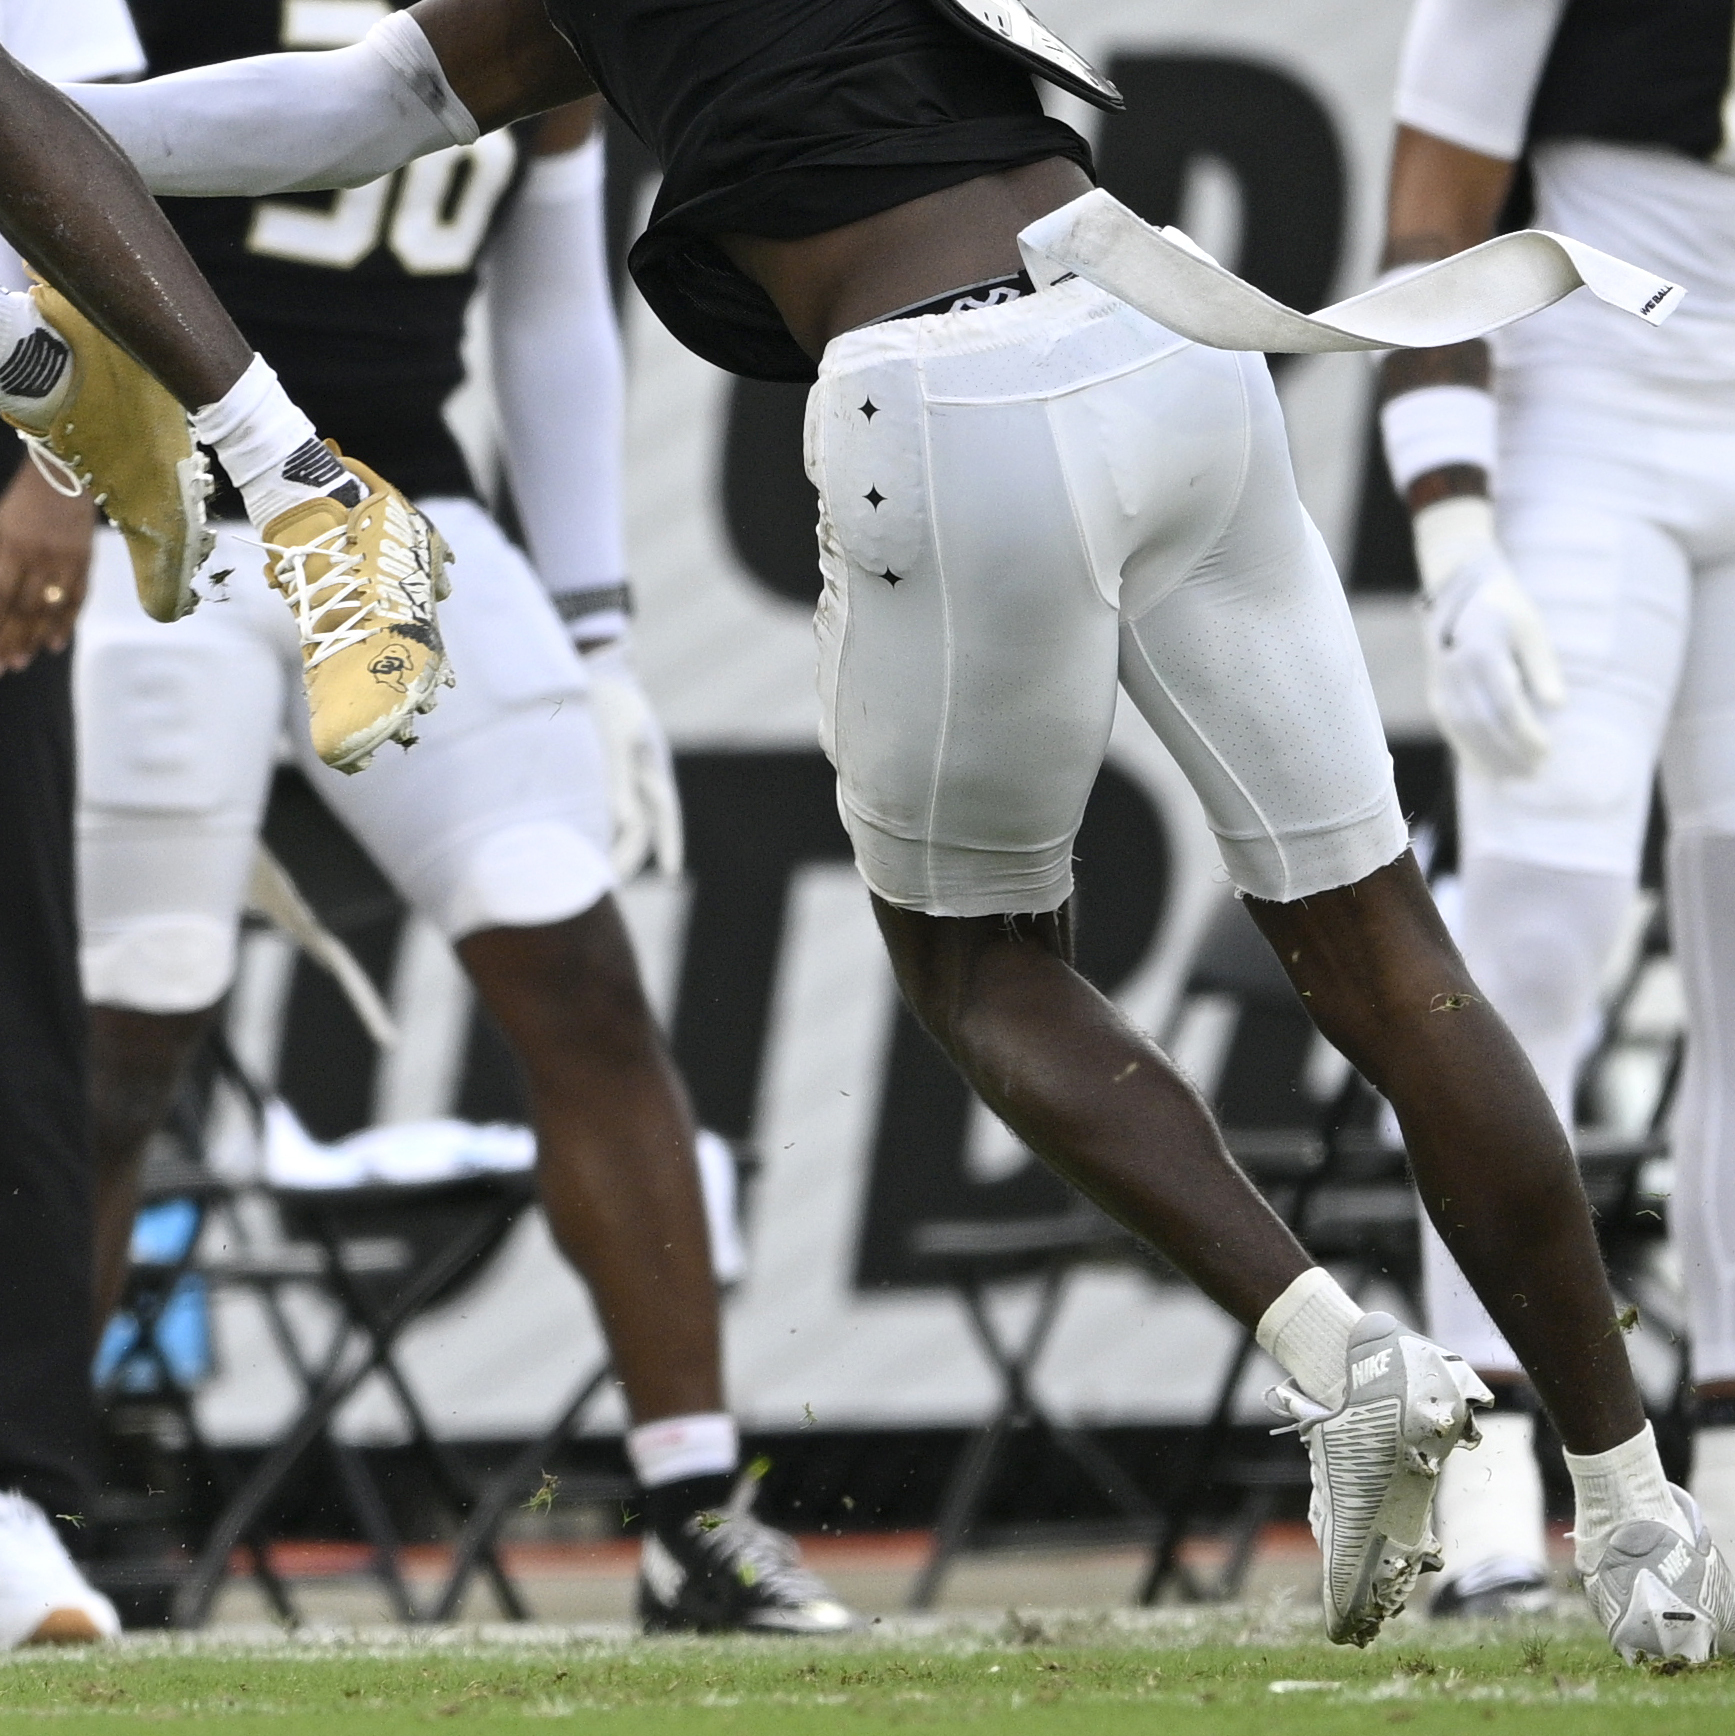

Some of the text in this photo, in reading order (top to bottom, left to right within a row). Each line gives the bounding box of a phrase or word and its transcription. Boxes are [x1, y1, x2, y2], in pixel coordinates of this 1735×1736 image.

[1652, 285, 1673, 304] BALL
[1351, 1347, 1394, 1391] NIKE
[1657, 1537, 1693, 1588] NIKE
